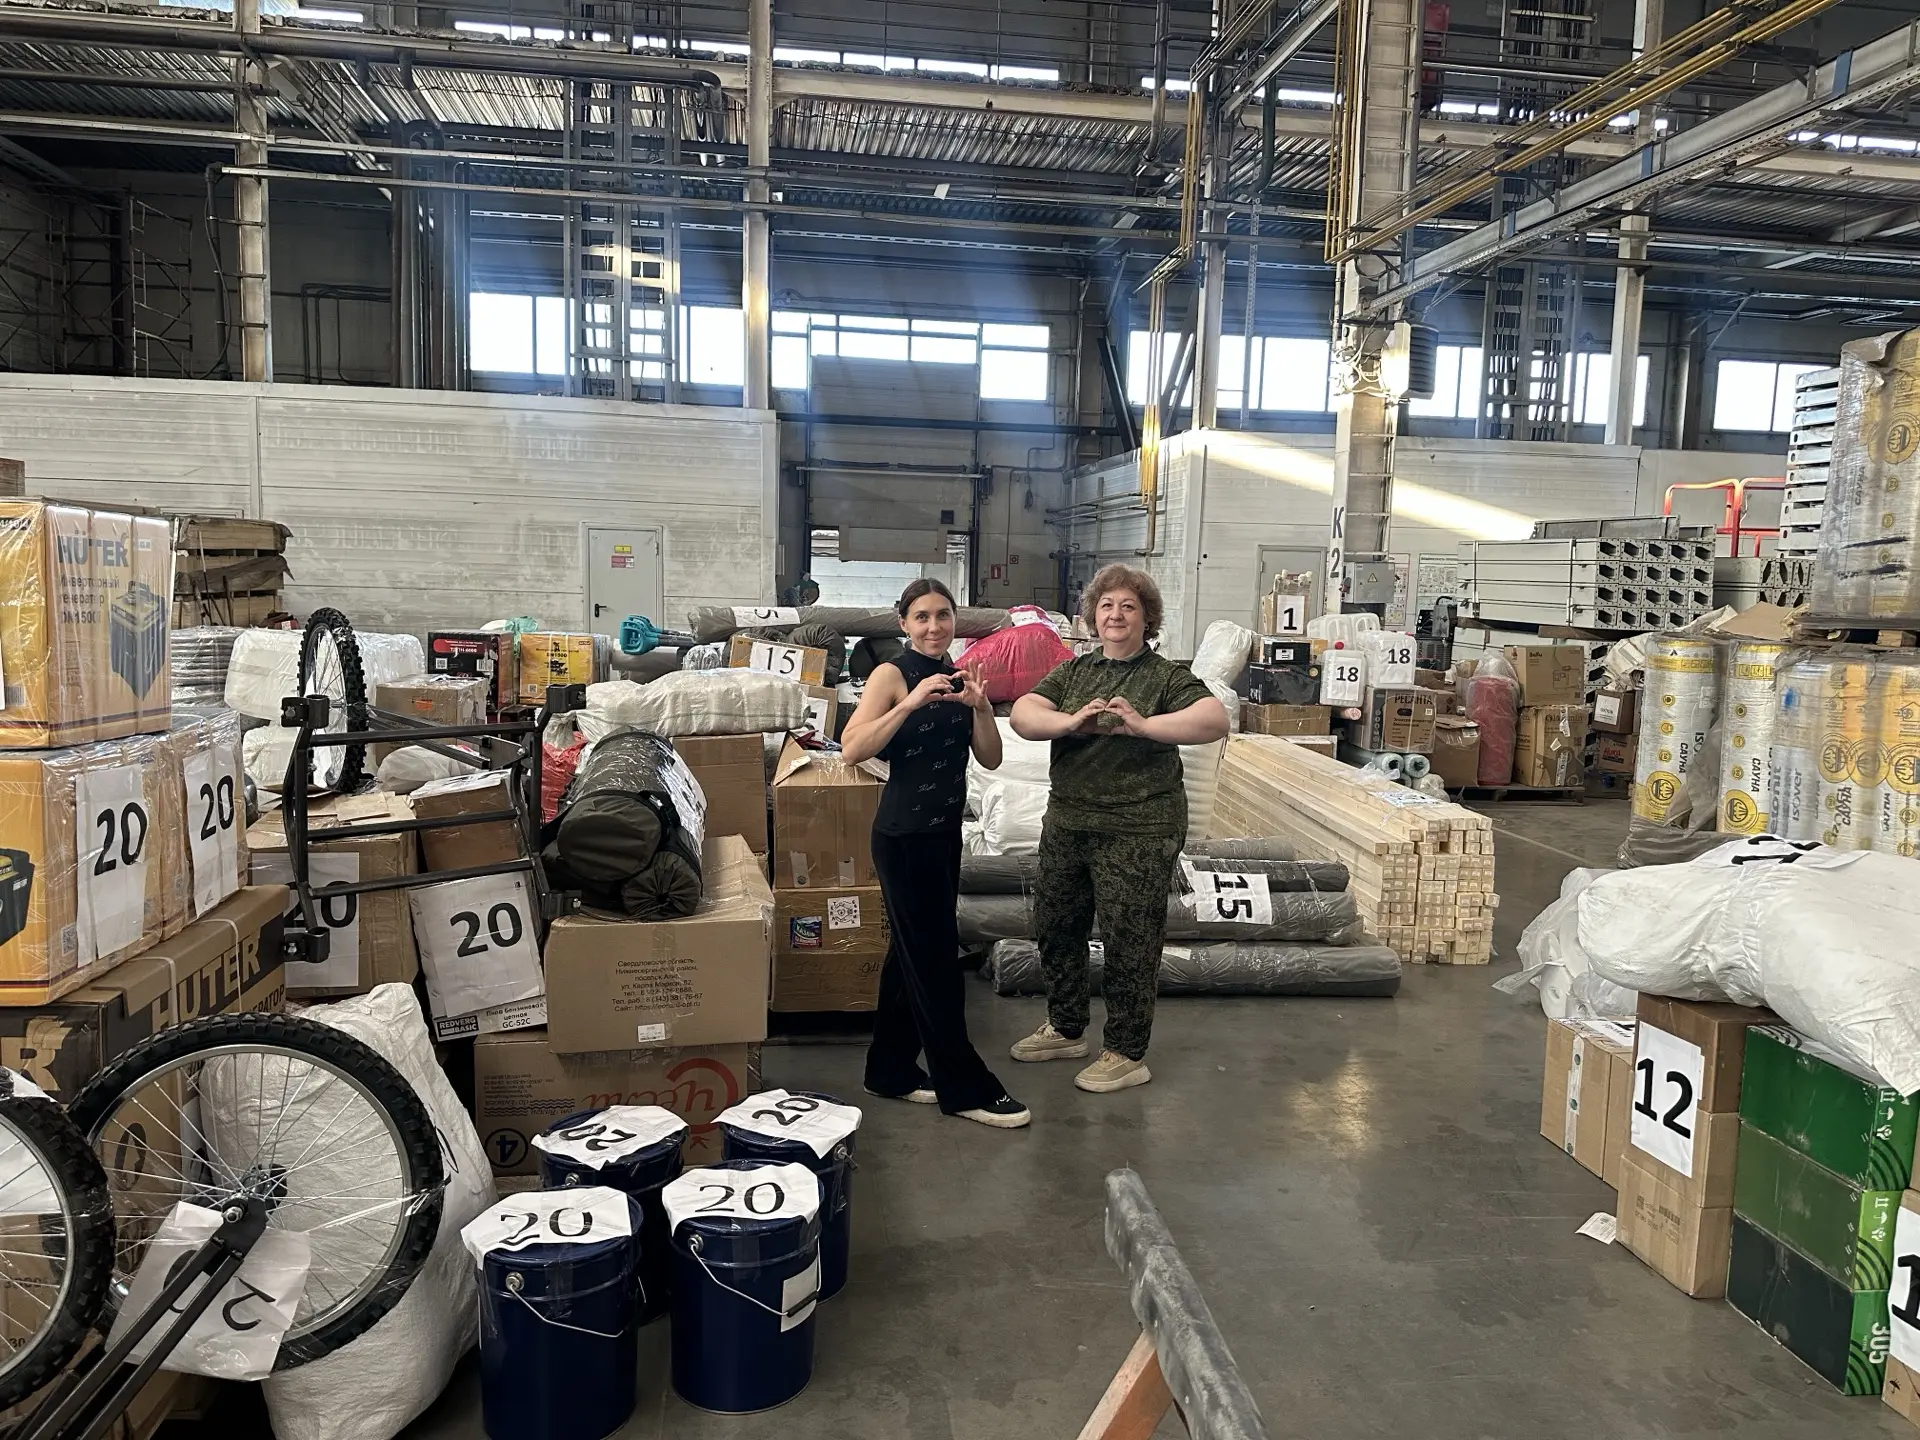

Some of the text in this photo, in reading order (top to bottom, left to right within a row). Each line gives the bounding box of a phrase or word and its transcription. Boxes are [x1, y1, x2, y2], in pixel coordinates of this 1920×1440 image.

[1330, 548, 1340, 578] 2
[1283, 608, 1297, 631] 1
[765, 647, 797, 674] 15
[1388, 648, 1411, 664] 18
[1336, 666, 1359, 682] 18
[1679, 742, 1688, 774] САУНА
[1751, 757, 1762, 793] САУНА
[200, 775, 234, 841] 20
[94, 802, 147, 876] 20
[1213, 873, 1252, 919] 15
[450, 902, 522, 958] 20
[152, 927, 261, 1033] HUTER
[440, 1016, 476, 1029] REDVERG
[454, 1024, 477, 1033] BASIC
[502, 1018, 531, 1028] GC-52C
[752, 1096, 820, 1128] 20
[1635, 1057, 1693, 1139] 12
[495, 1134, 518, 1162] 4
[559, 1123, 637, 1151] 20
[694, 1182, 785, 1215] 20
[500, 1207, 592, 1246] 20
